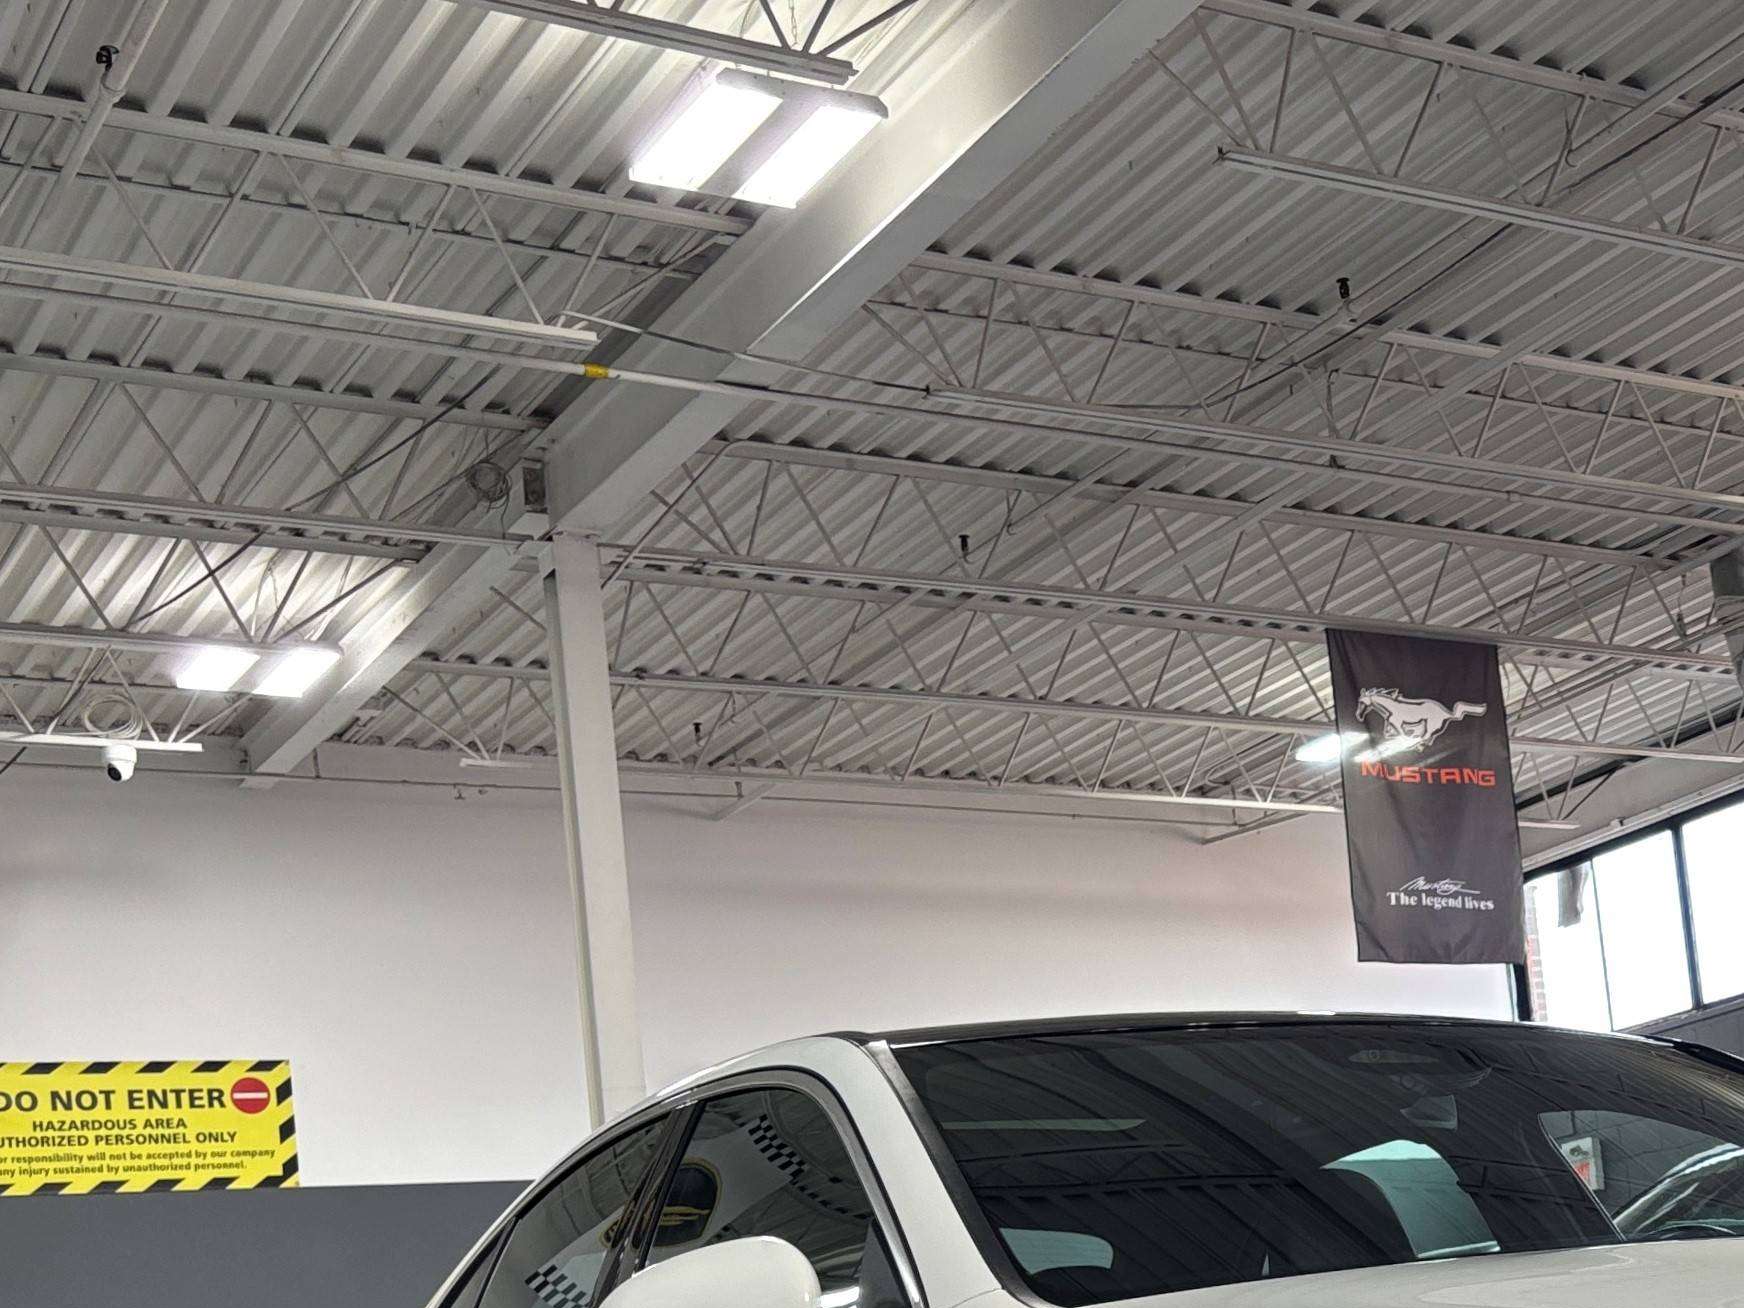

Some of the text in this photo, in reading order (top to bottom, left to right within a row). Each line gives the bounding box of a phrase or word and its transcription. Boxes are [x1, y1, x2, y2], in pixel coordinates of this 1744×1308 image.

[1361, 759, 1496, 786] MUSTANG
[1386, 891, 1495, 911] The legend lives
[0, 1087, 227, 1113] DO NOT ENTER
[32, 1117, 188, 1133] HAZARDOUS AREA
[94, 1132, 191, 1147] PERSONNEL
[195, 1131, 238, 1144] ONLY
[11, 1151, 84, 1165] responsibility
[87, 1151, 106, 1162] will
[109, 1151, 127, 1162] not
[129, 1149, 143, 1161] be
[146, 1149, 193, 1161] accepted
[195, 1148, 208, 1160] by
[210, 1150, 228, 1159] our
[230, 1149, 276, 1160] company
[19, 1165, 51, 1178] injury
[53, 1163, 104, 1176] sustained
[107, 1163, 120, 1175] by
[122, 1160, 192, 1173] unauthorized
